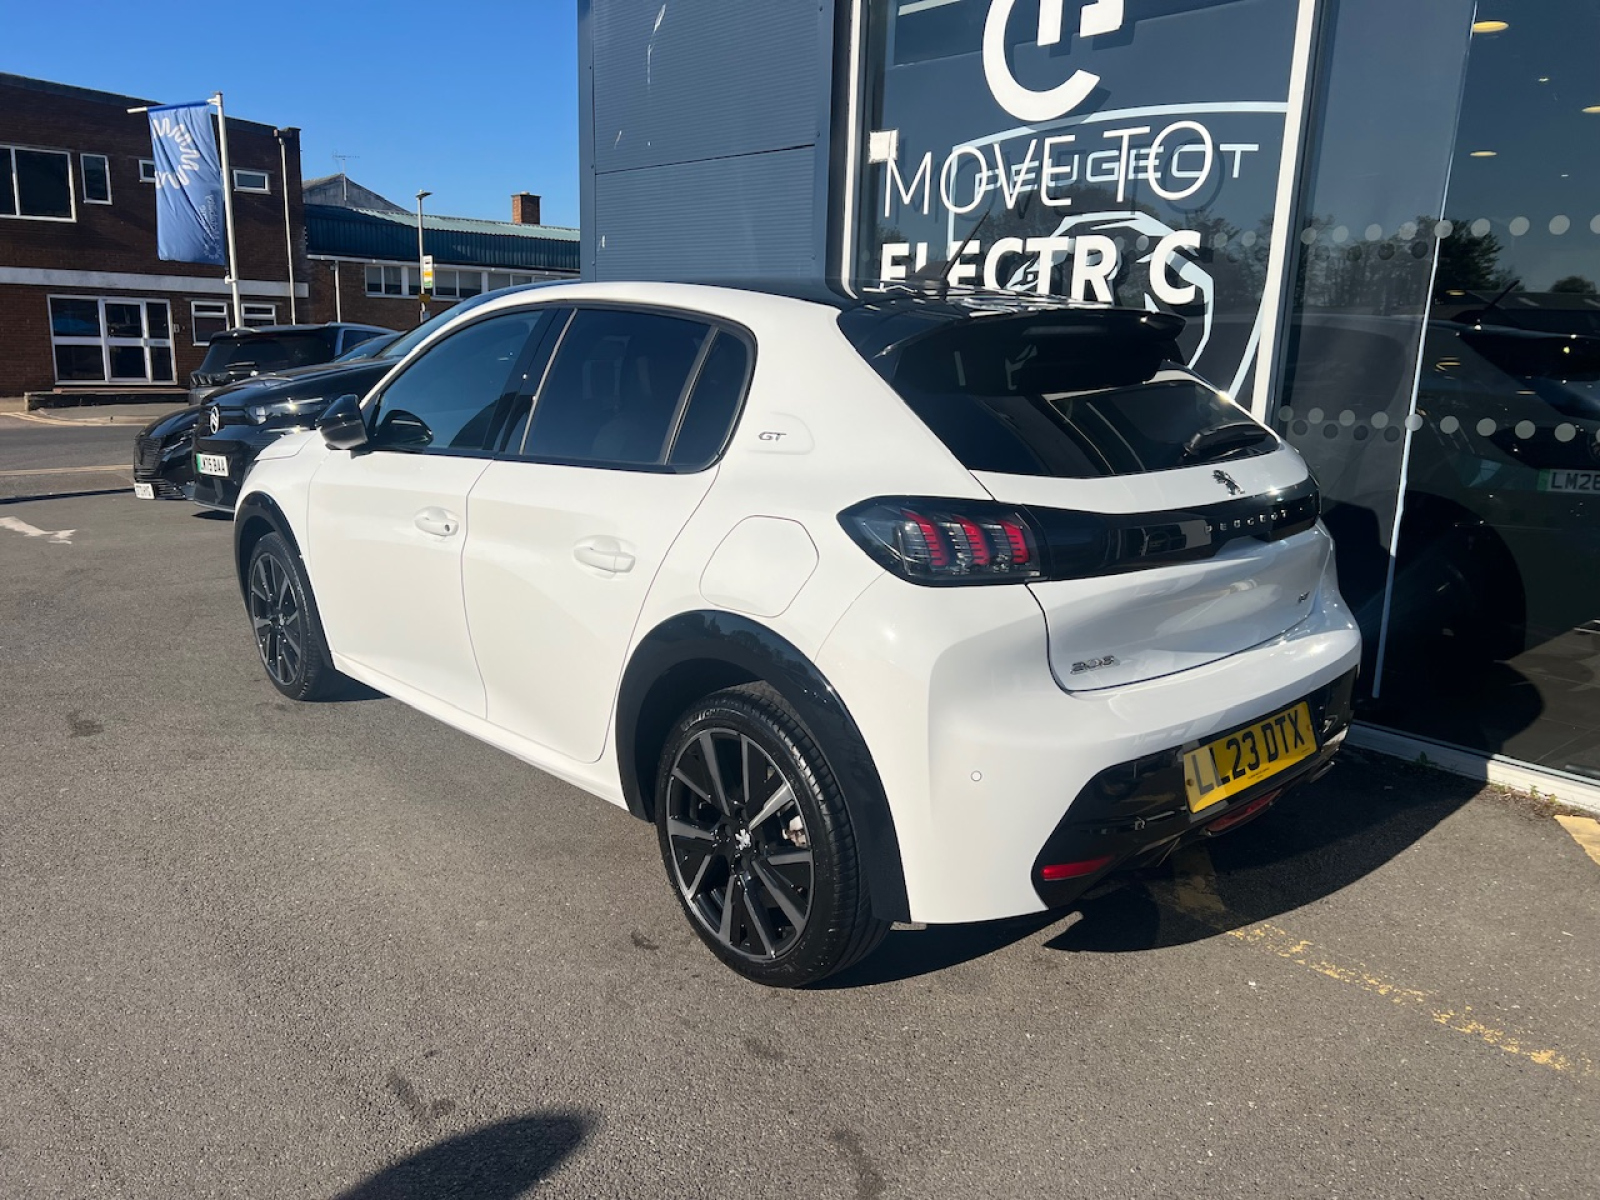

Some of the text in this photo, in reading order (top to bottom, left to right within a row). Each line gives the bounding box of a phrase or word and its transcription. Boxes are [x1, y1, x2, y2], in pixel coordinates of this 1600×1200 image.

[884, 120, 1213, 218] MOVE TO
[974, 143, 1259, 201] PEUGEOT
[758, 431, 787, 442] GT
[1191, 709, 1305, 796] LL23 DTX
